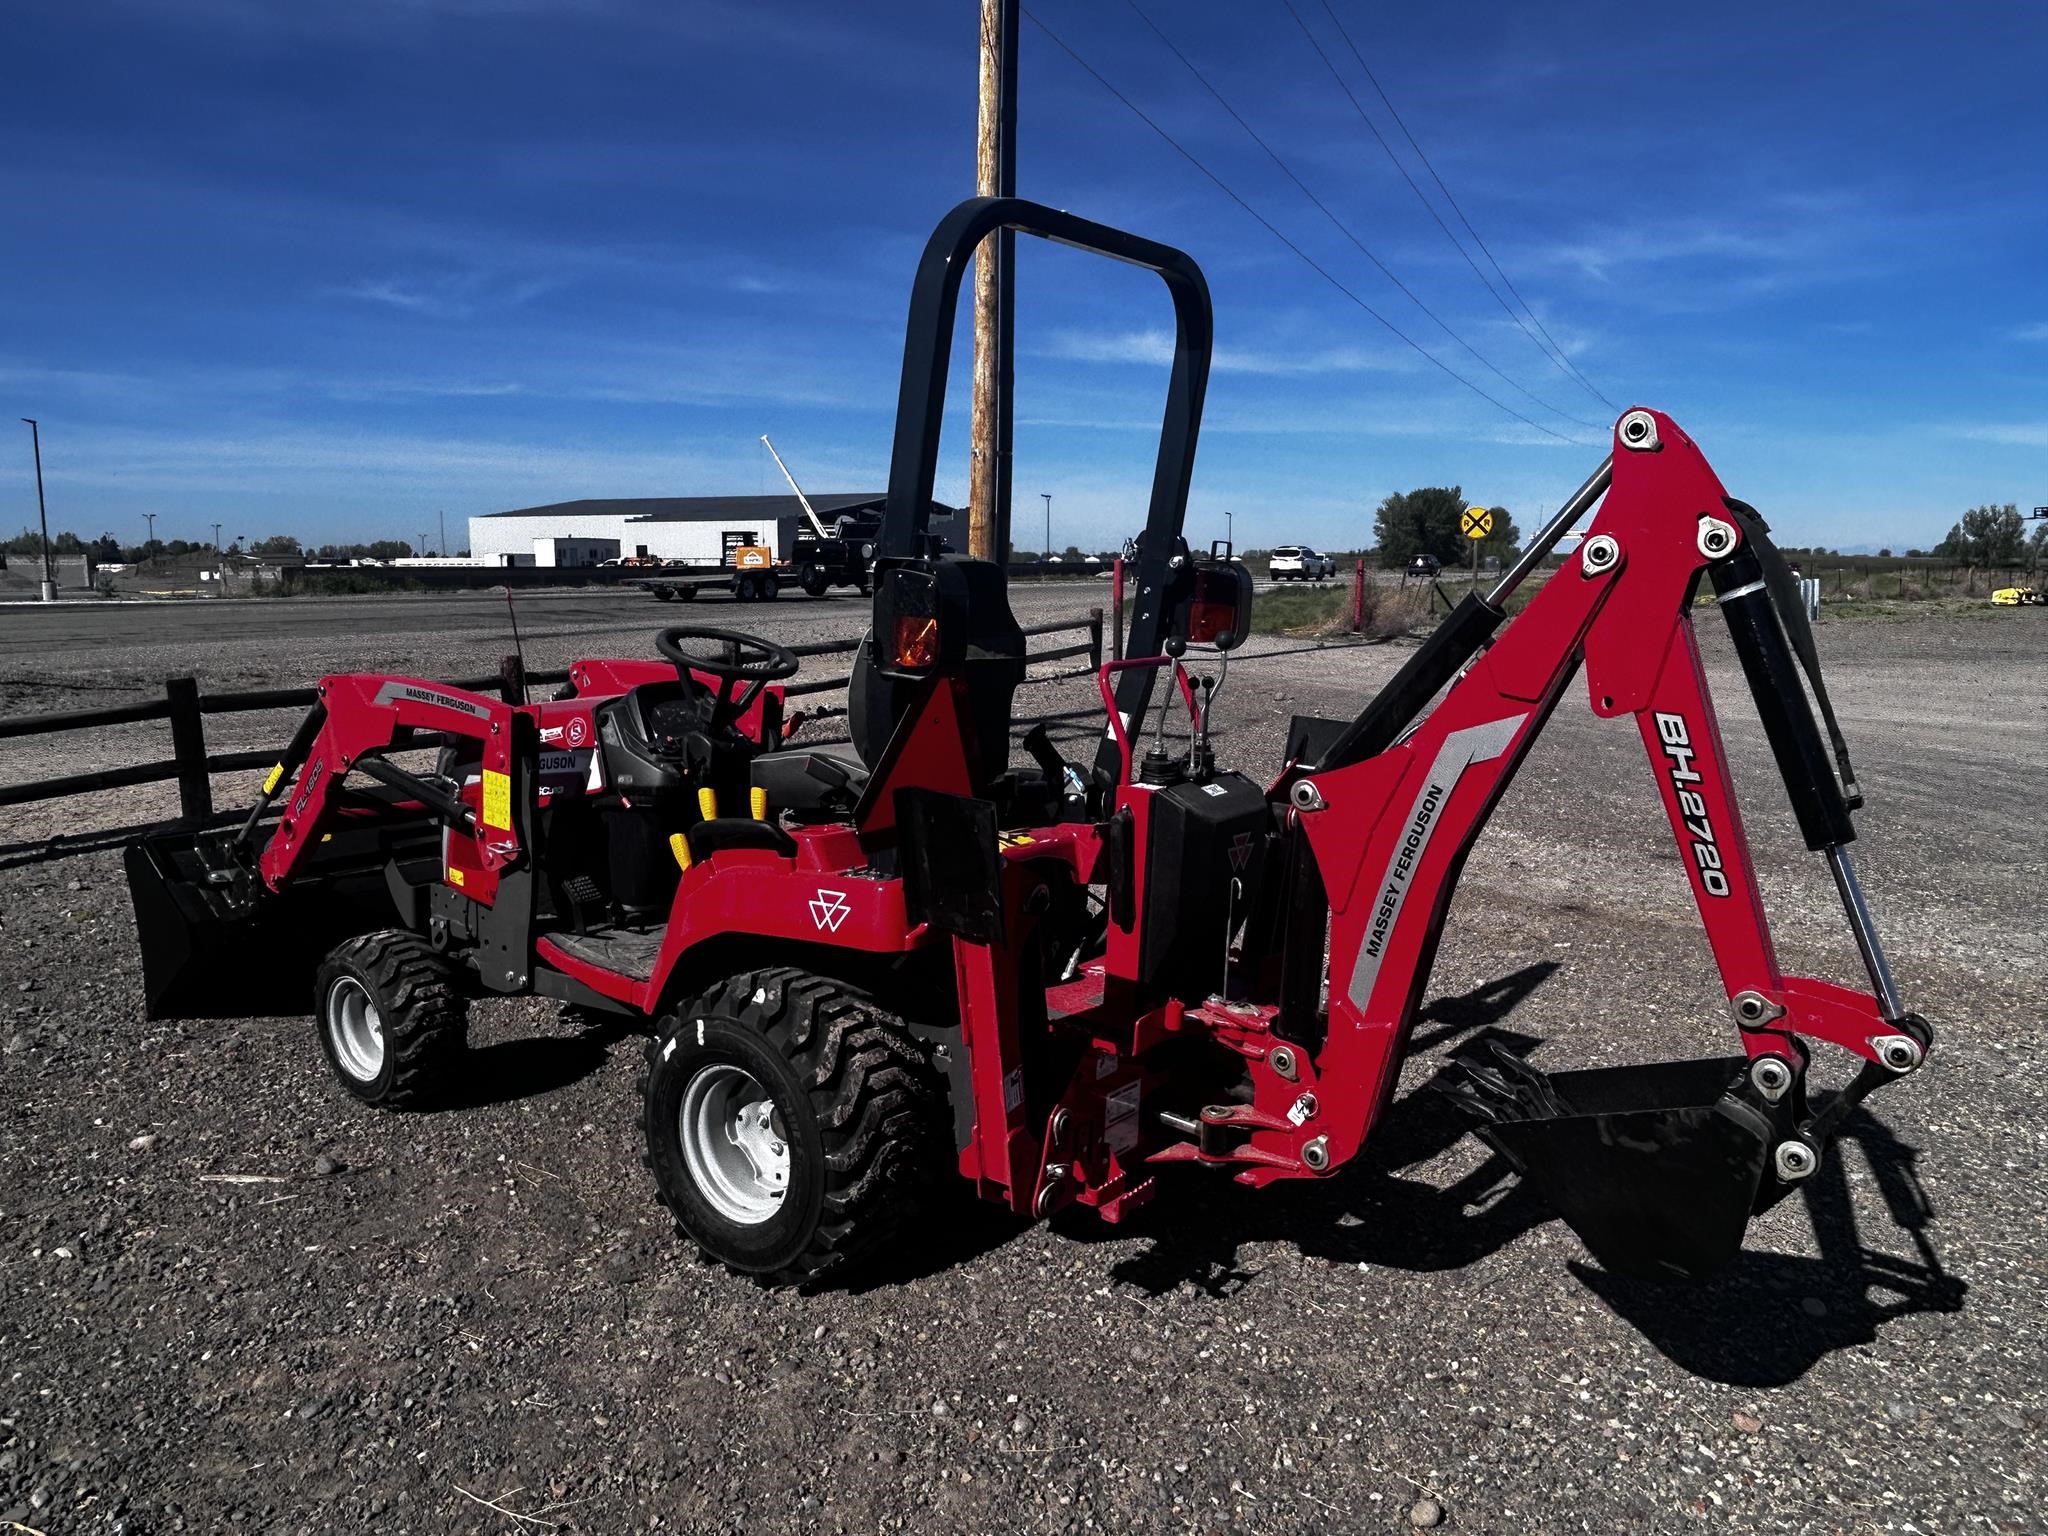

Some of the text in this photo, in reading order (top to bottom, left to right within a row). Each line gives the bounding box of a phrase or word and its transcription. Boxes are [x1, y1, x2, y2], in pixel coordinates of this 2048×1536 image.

[406, 687, 476, 714] MASSEY FERGUSON
[538, 755, 576, 770] GUSON
[1654, 712, 1731, 897] BH.2720
[1366, 784, 1444, 958] MASSEY FERGUSON
